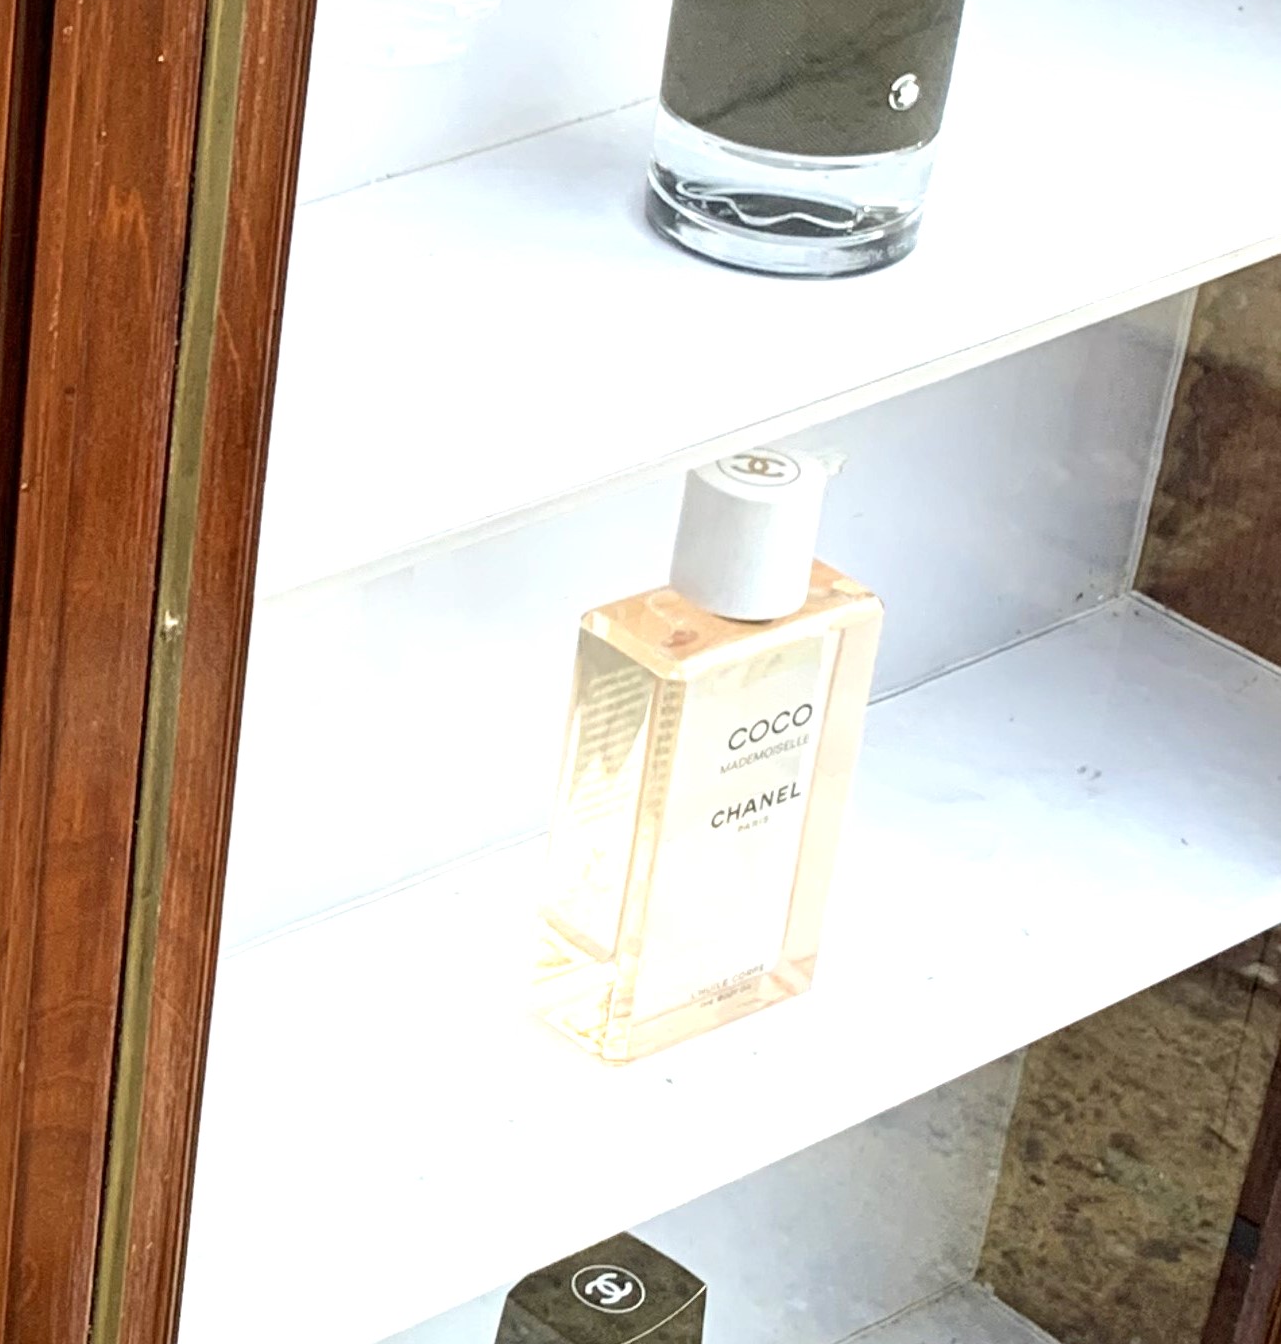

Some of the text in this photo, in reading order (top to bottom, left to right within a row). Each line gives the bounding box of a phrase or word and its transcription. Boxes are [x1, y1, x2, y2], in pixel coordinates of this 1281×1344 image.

[727, 702, 813, 751] COCO
[719, 733, 810, 775] MADEMOISELLE
[710, 780, 801, 829] CHANEL
